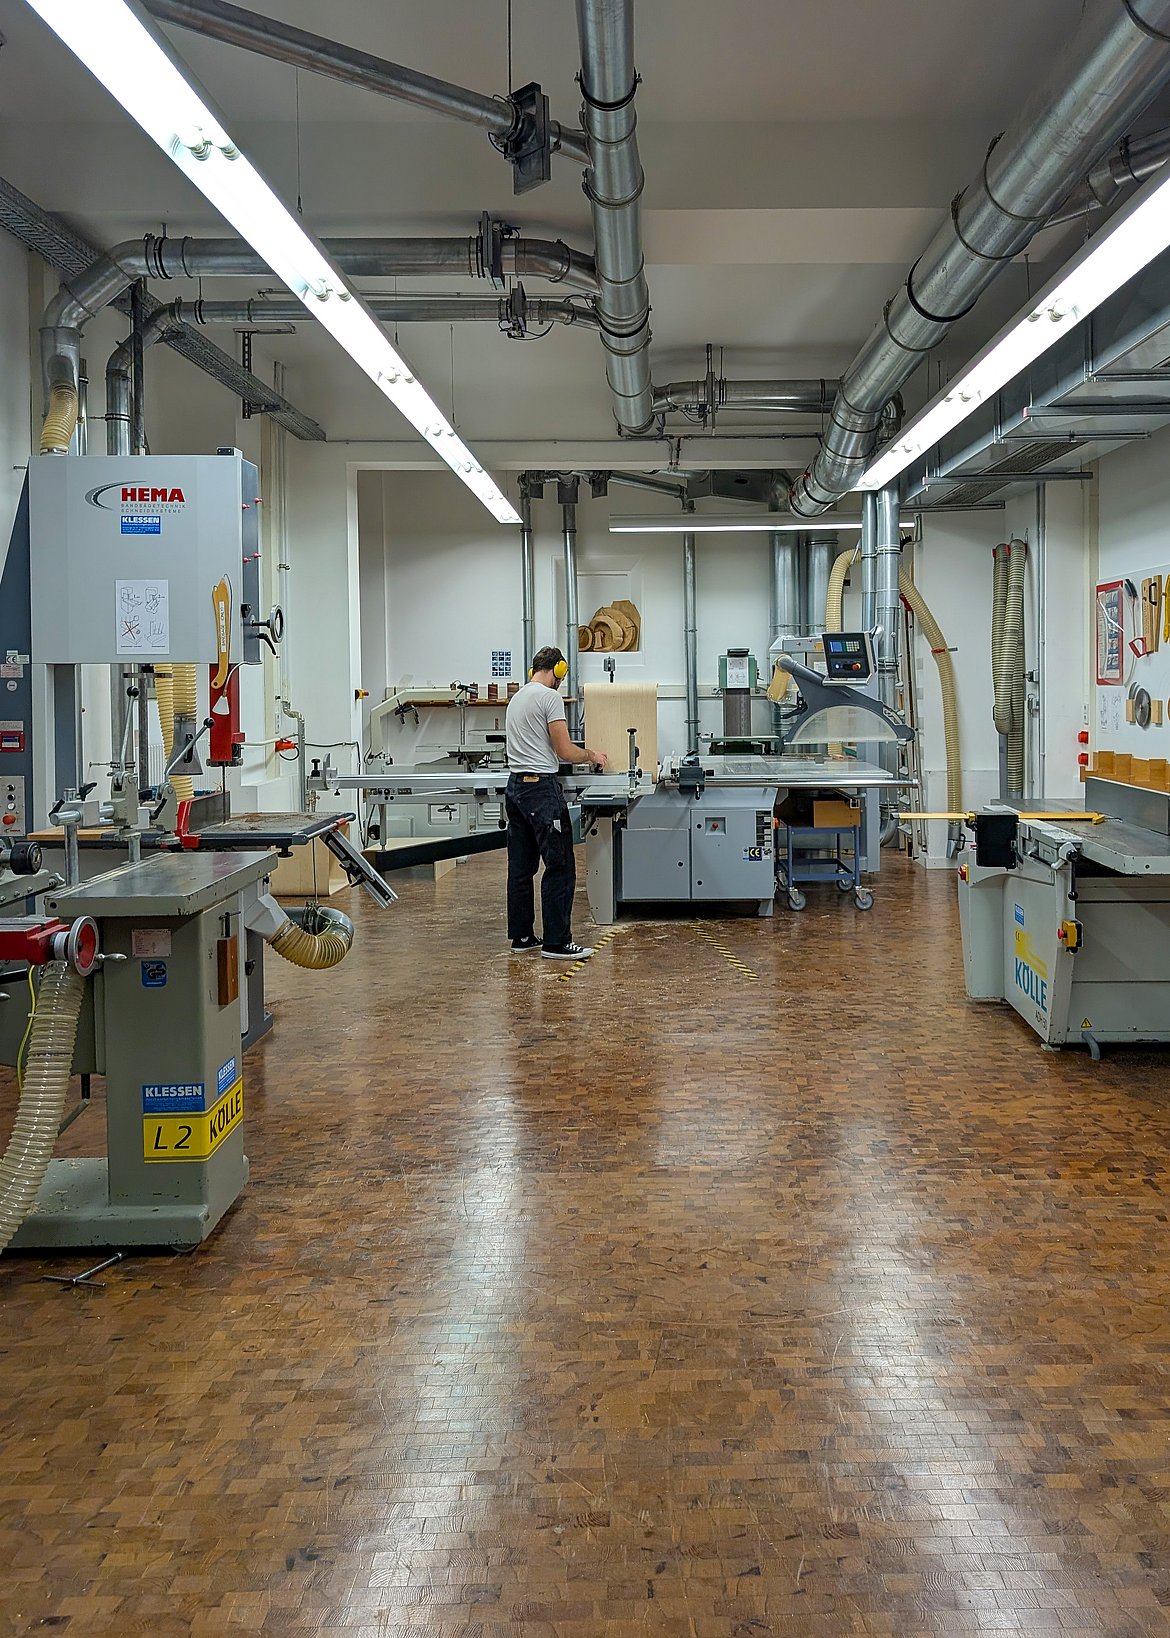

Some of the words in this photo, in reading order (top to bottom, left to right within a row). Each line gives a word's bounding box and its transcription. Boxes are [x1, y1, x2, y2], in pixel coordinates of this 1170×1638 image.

[121, 488, 185, 502] HEMA
[122, 516, 160, 524] KLESSEN
[1015, 957, 1047, 1013] KÖLLE
[145, 1086, 202, 1098] KLESSEN
[209, 1089, 241, 1144] KÖLLE
